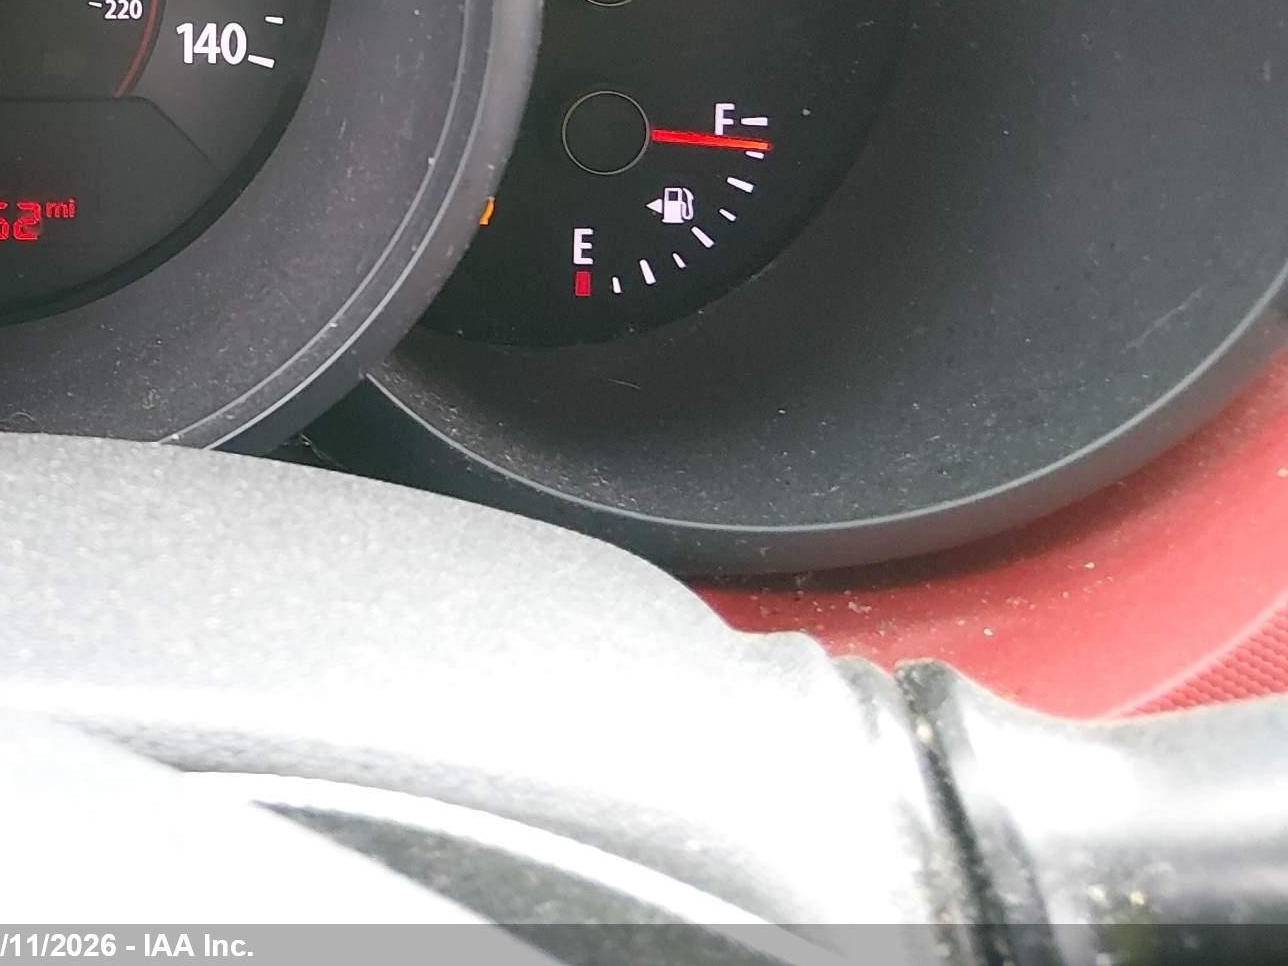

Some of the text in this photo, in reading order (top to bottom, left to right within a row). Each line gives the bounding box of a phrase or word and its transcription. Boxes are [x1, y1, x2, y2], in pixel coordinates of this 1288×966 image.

[175, 22, 248, 66] 140
[714, 102, 736, 136] F
[45, 198, 77, 219] mi
[573, 227, 595, 266] E
